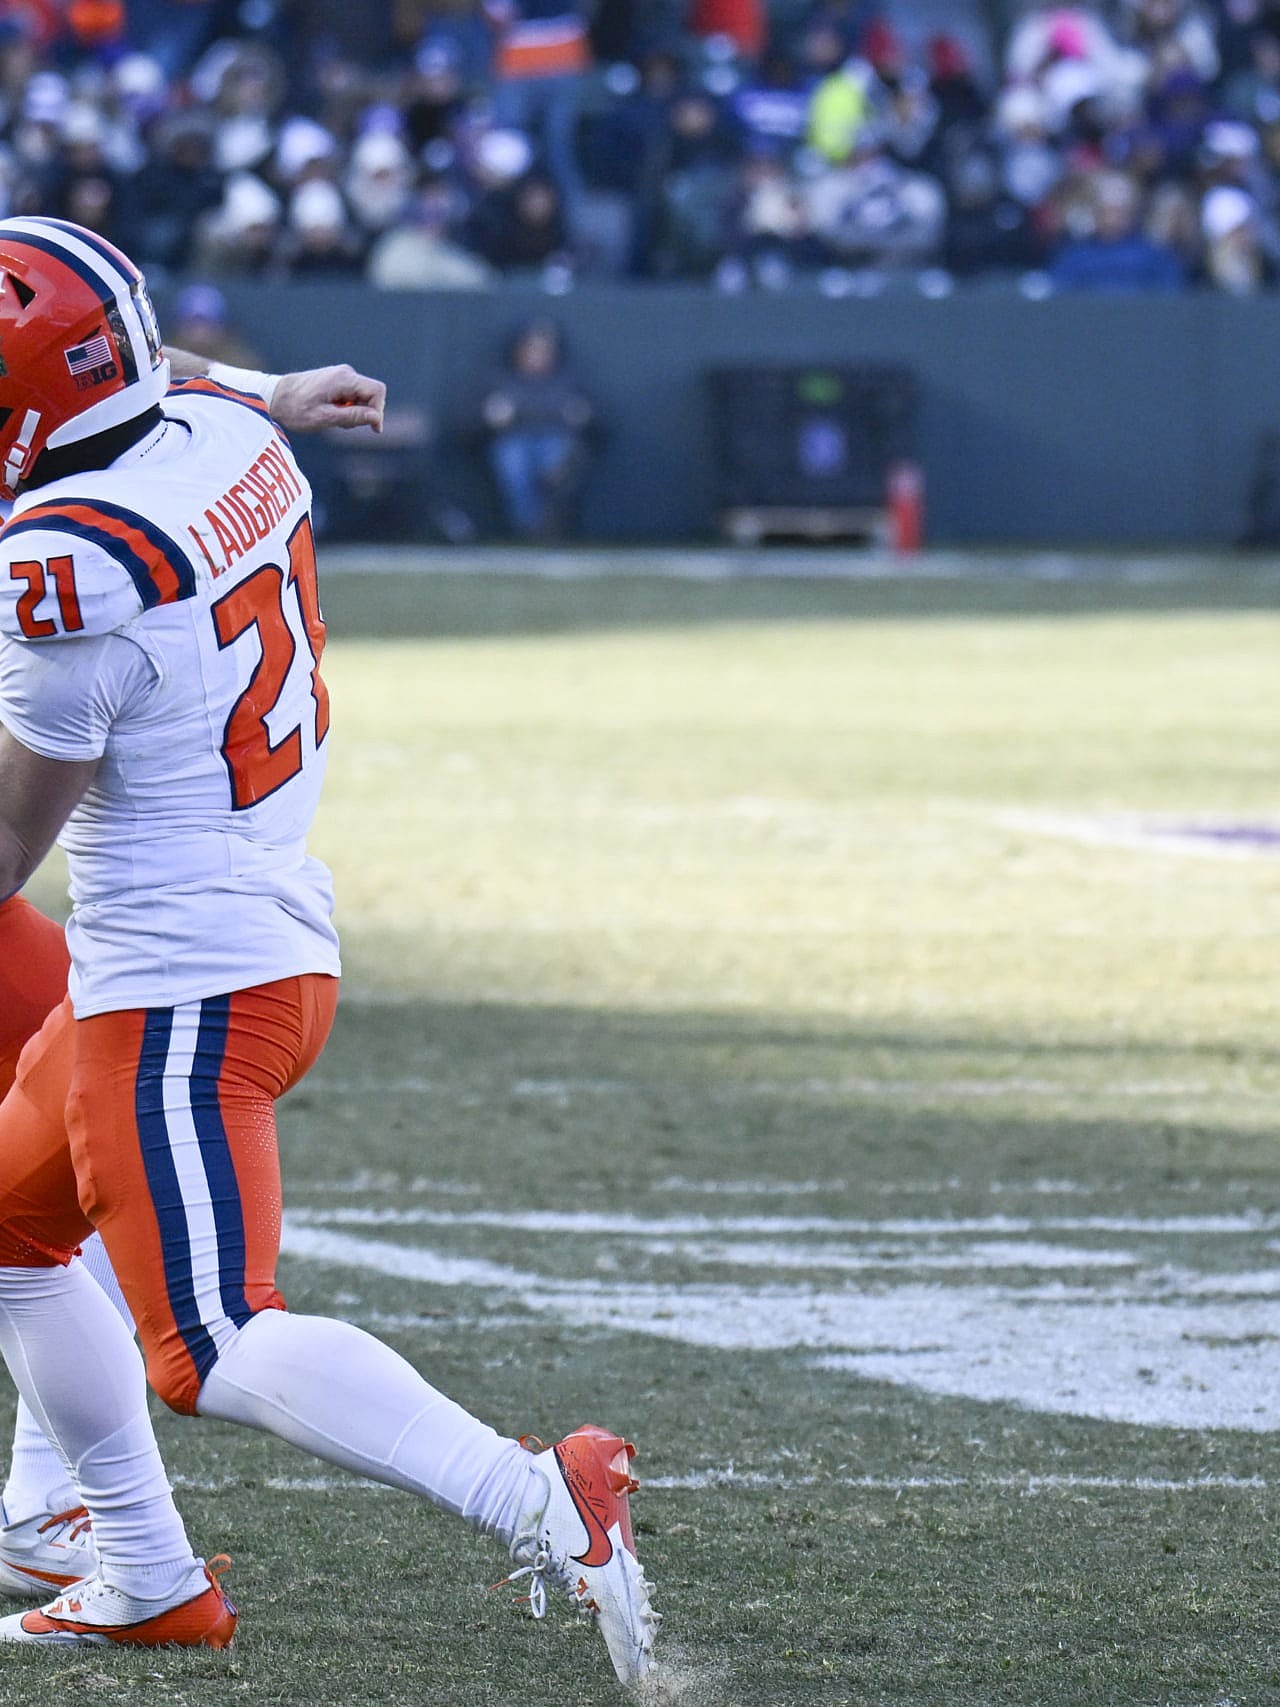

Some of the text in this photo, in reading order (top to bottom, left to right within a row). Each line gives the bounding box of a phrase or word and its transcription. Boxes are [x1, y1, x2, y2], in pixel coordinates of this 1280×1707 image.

[187, 439, 302, 580] LAUGHERY
[10, 554, 85, 639] 21
[210, 510, 330, 812] 21
